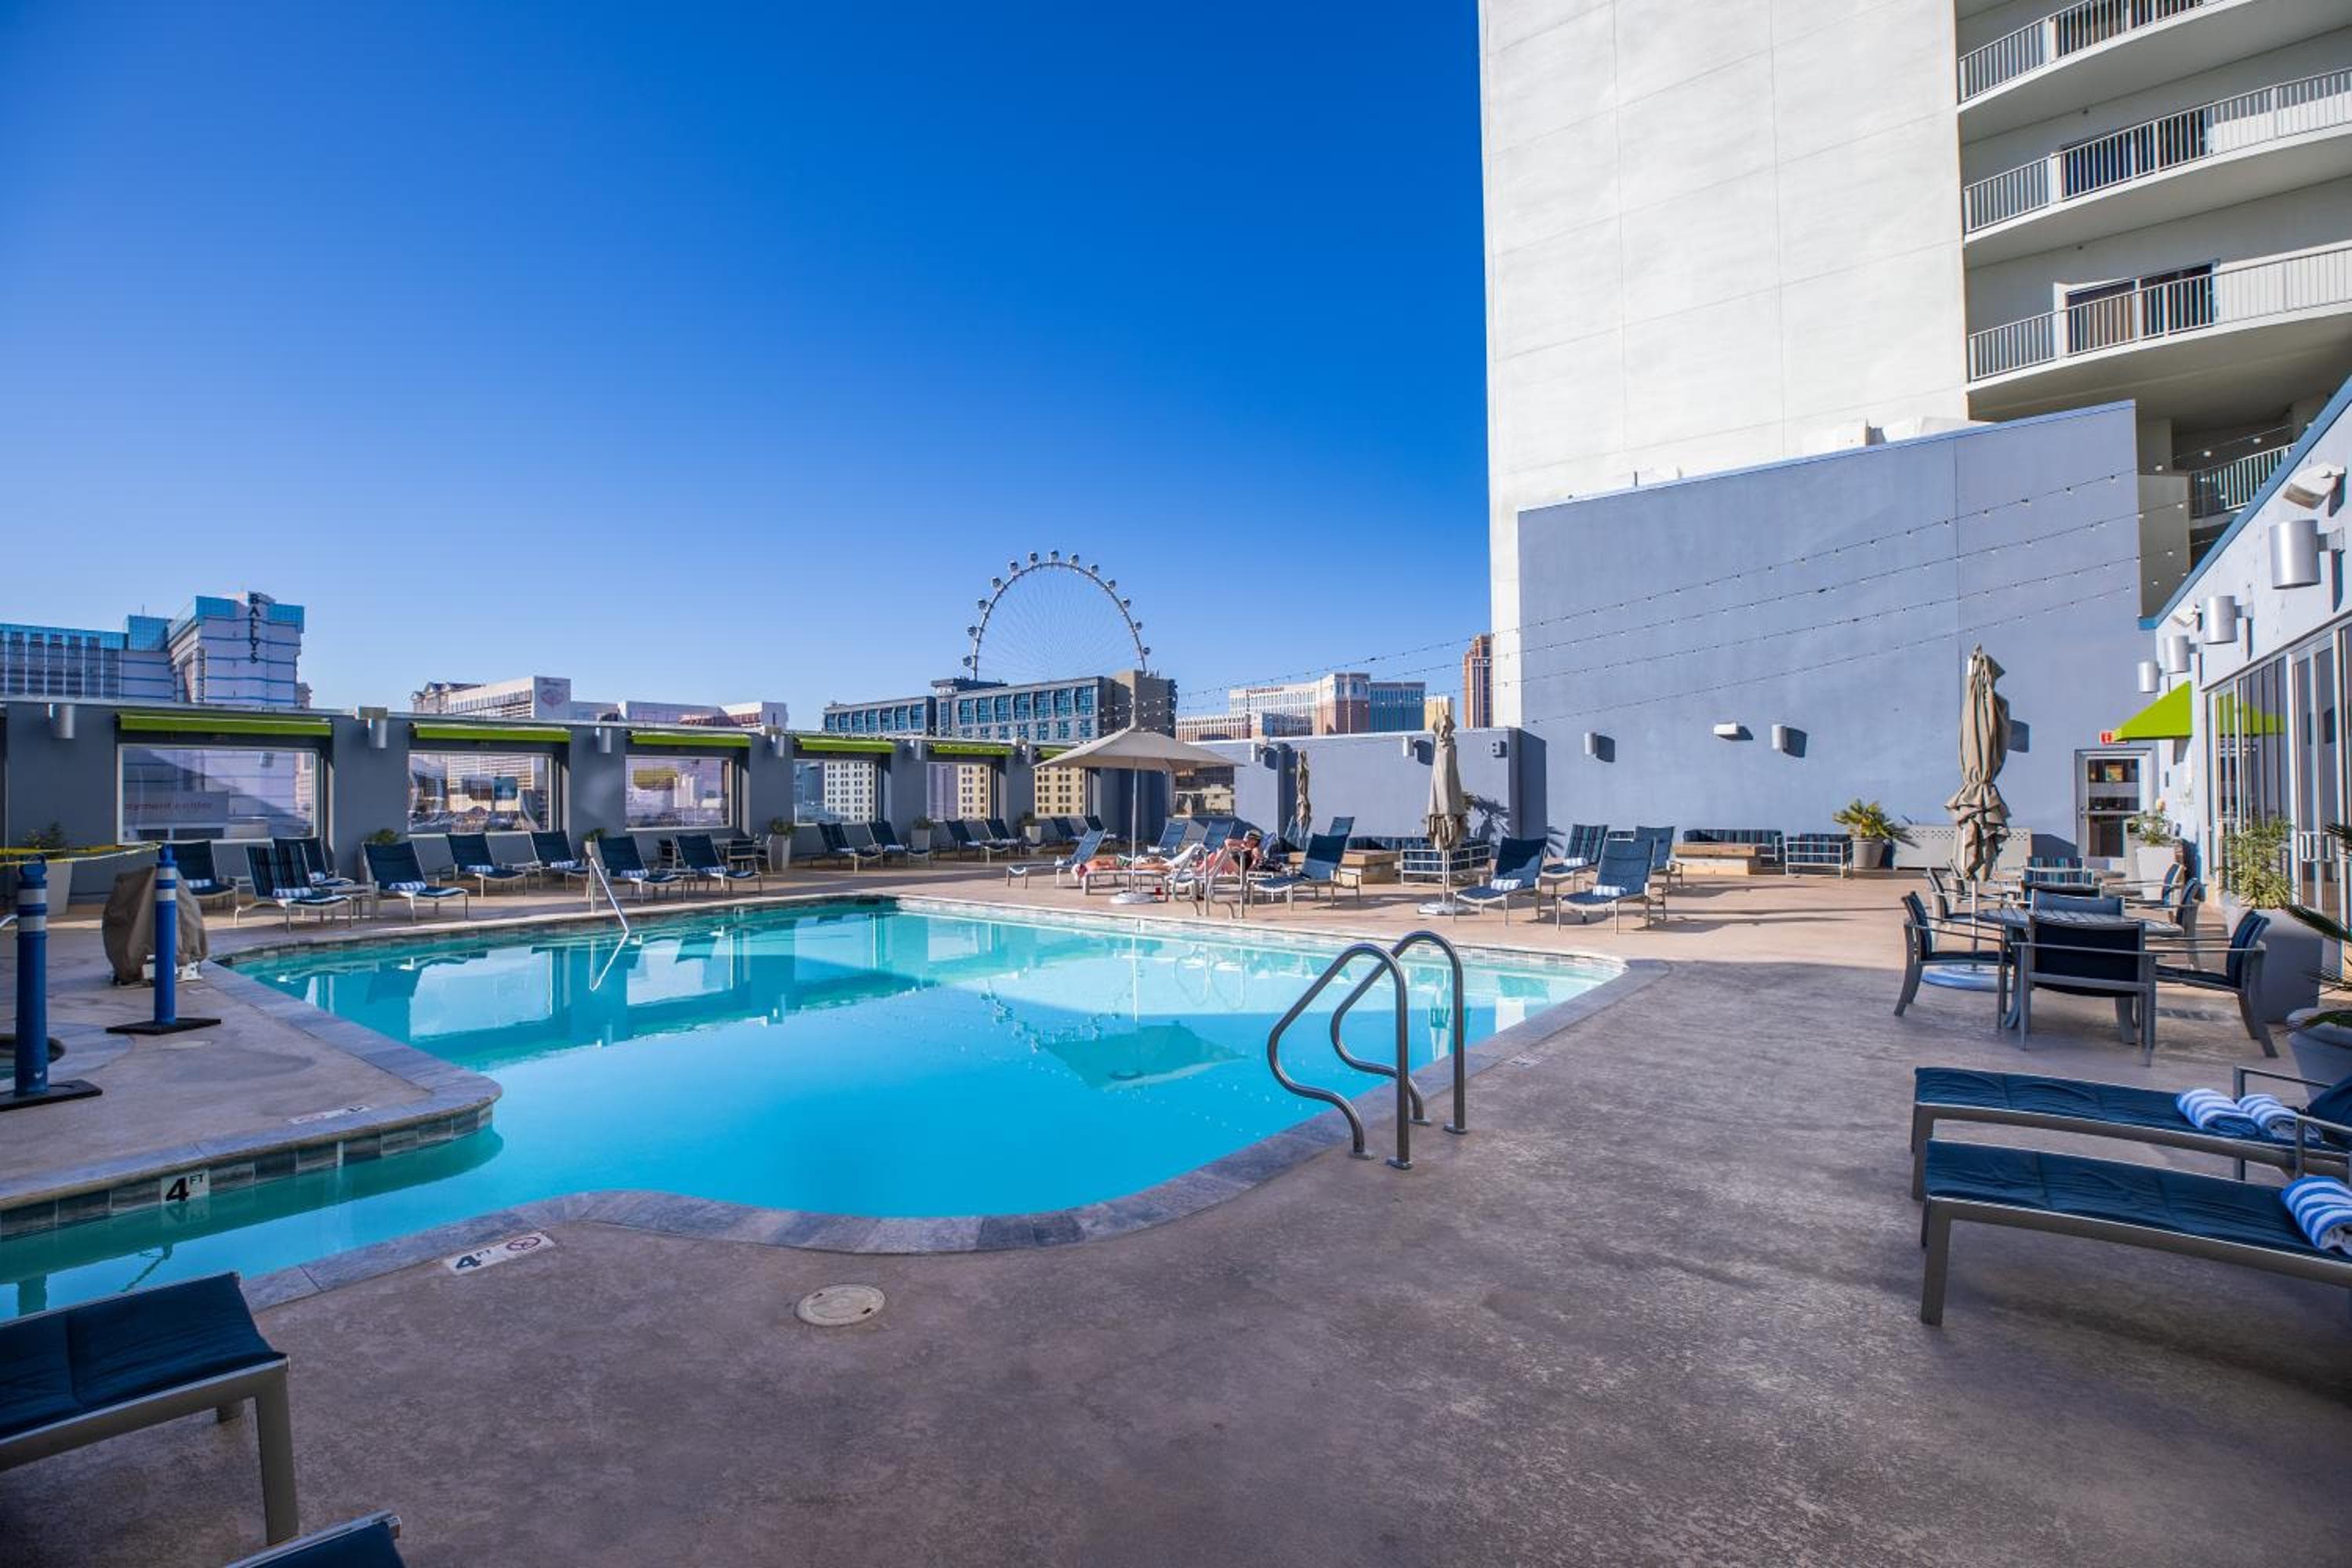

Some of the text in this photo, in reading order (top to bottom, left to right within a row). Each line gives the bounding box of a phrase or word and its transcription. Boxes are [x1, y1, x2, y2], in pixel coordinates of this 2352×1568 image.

[165, 1174, 203, 1201] 4 FT
[456, 1255, 481, 1269] 4
